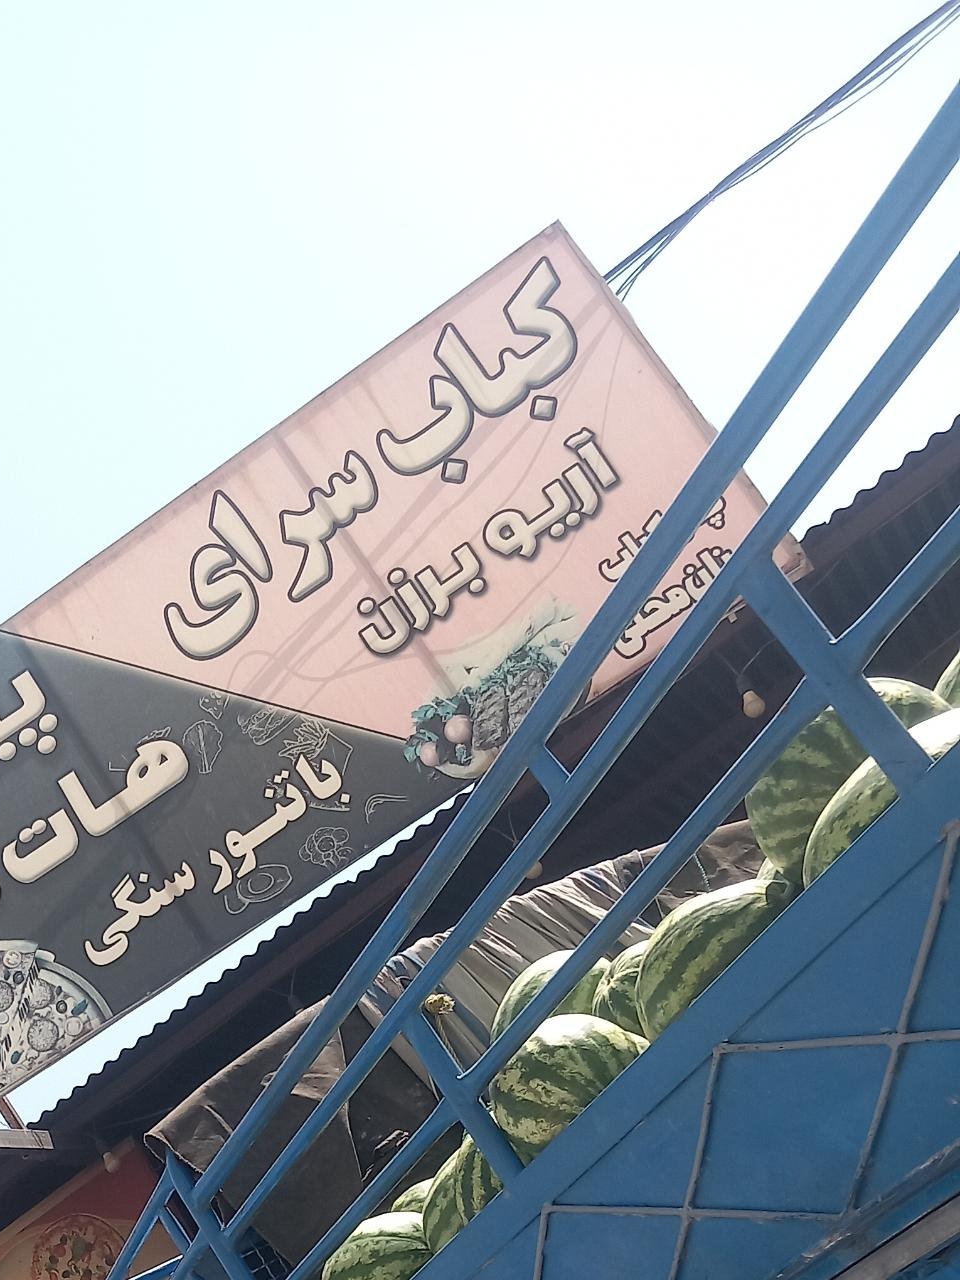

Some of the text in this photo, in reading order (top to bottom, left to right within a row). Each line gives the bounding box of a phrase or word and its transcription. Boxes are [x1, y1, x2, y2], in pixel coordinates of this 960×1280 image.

[164, 256, 578, 661] کباب سرای
[356, 428, 620, 657] آریو برزن
[1, 738, 190, 884] هات
[84, 860, 197, 968] سنگی
